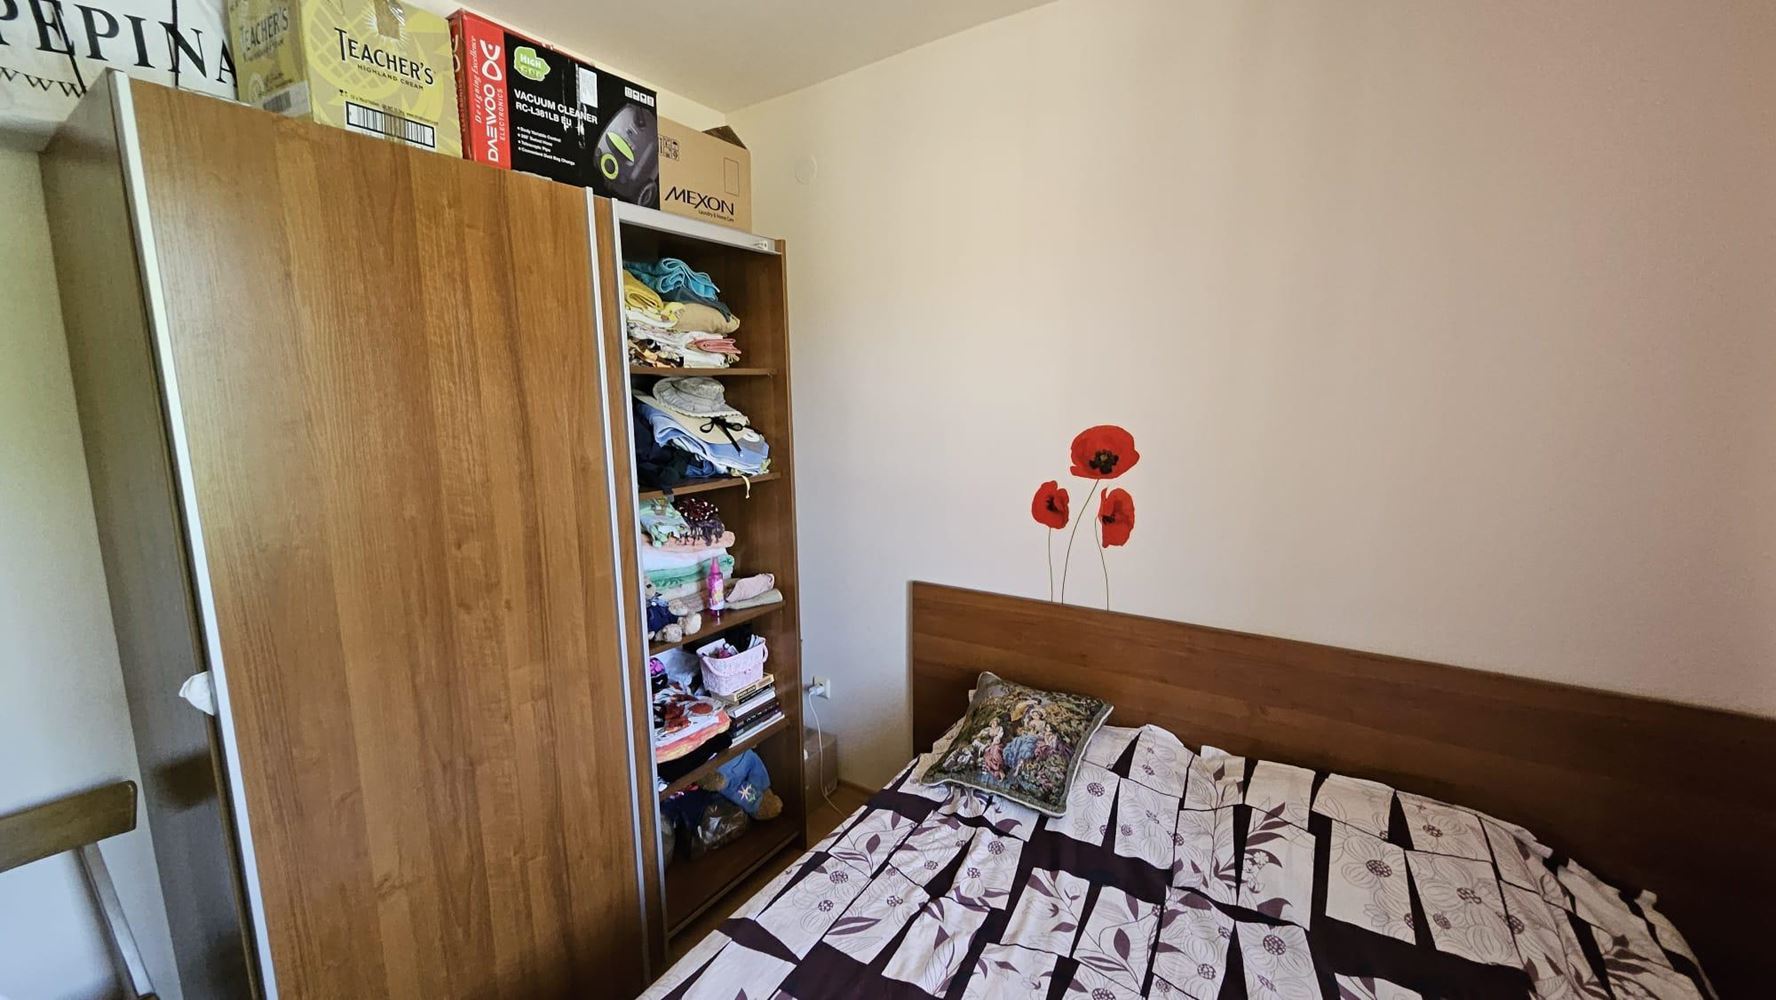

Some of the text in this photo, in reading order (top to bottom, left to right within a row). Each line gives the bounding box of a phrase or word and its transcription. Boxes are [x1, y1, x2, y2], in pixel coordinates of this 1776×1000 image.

[334, 27, 435, 86] TEACHER'S
[520, 53, 542, 69] HIGH
[357, 63, 424, 90] HIGHLAND CREAM
[473, 73, 483, 124] Designing
[497, 88, 506, 142] ELECTRONICS
[514, 88, 598, 124] VACUUM CLEANER
[515, 101, 560, 122] RC-L381LB
[483, 83, 500, 163] DAEWOO
[665, 186, 734, 216] MEXON
